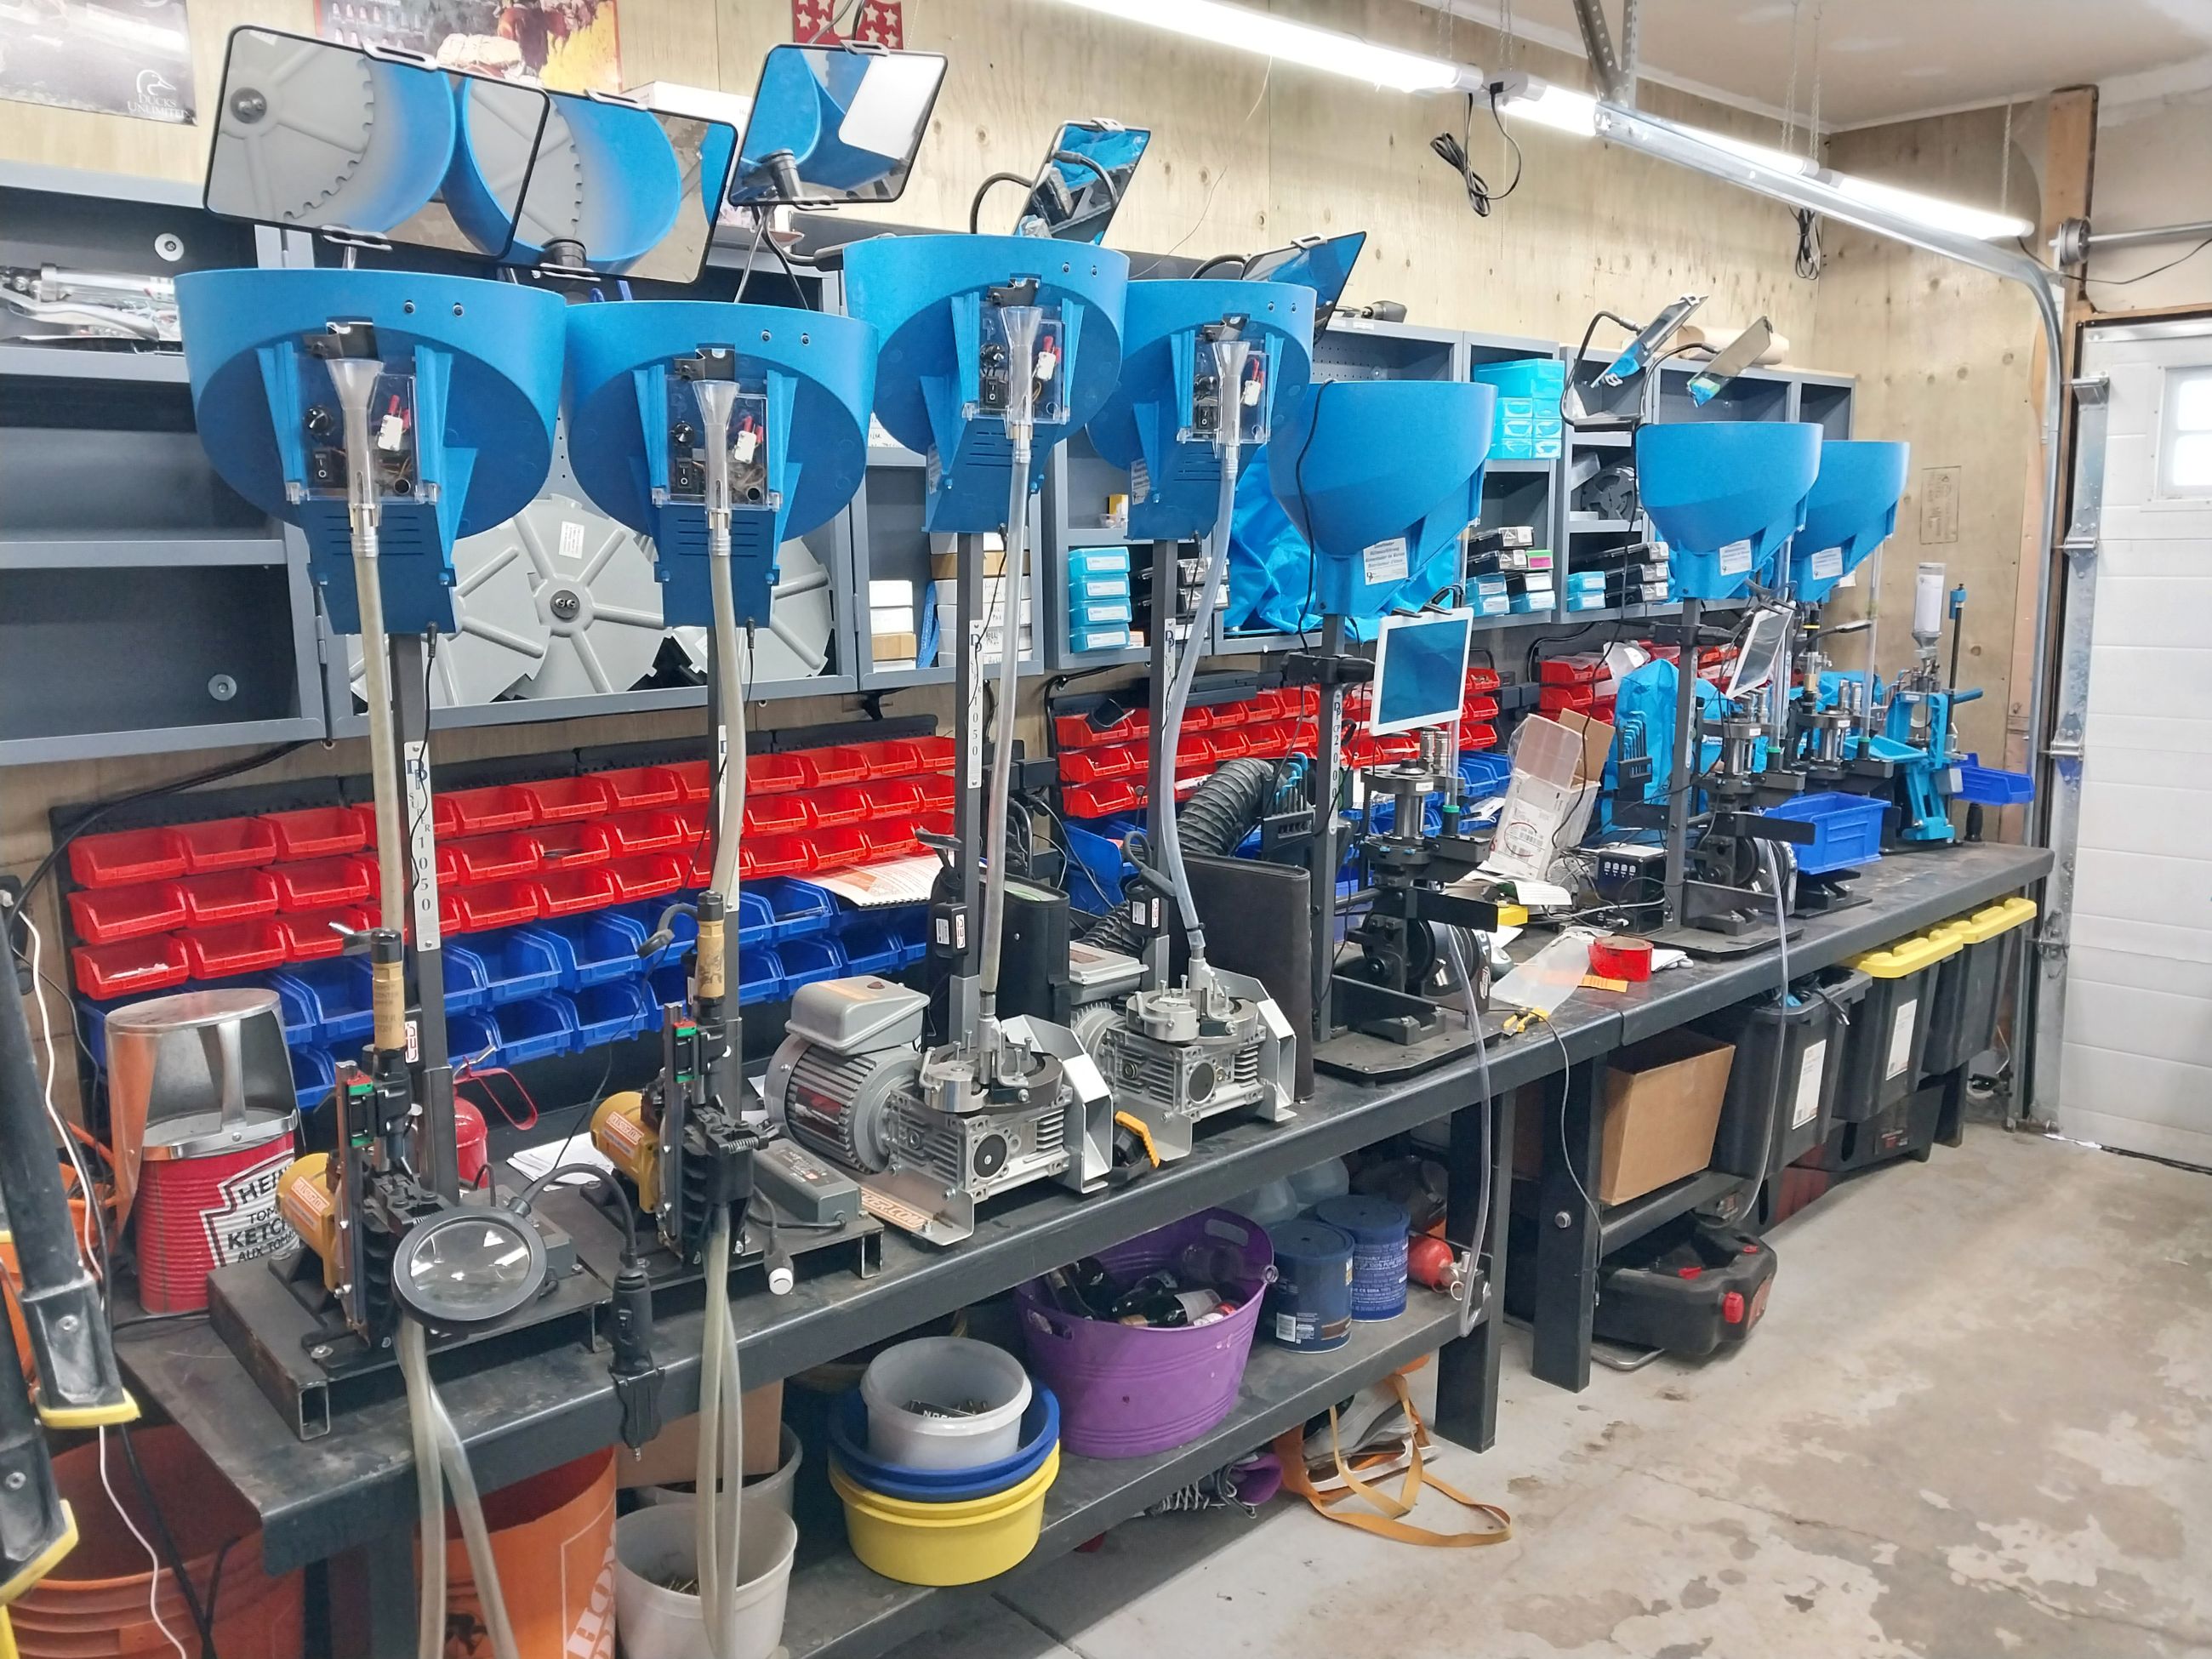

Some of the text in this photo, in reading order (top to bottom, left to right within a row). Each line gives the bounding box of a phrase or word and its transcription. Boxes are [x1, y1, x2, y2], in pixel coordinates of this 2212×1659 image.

[138, 94, 177, 108] DUCKS
[417, 835, 431, 912] 1050
[237, 1247, 265, 1263] AUX
